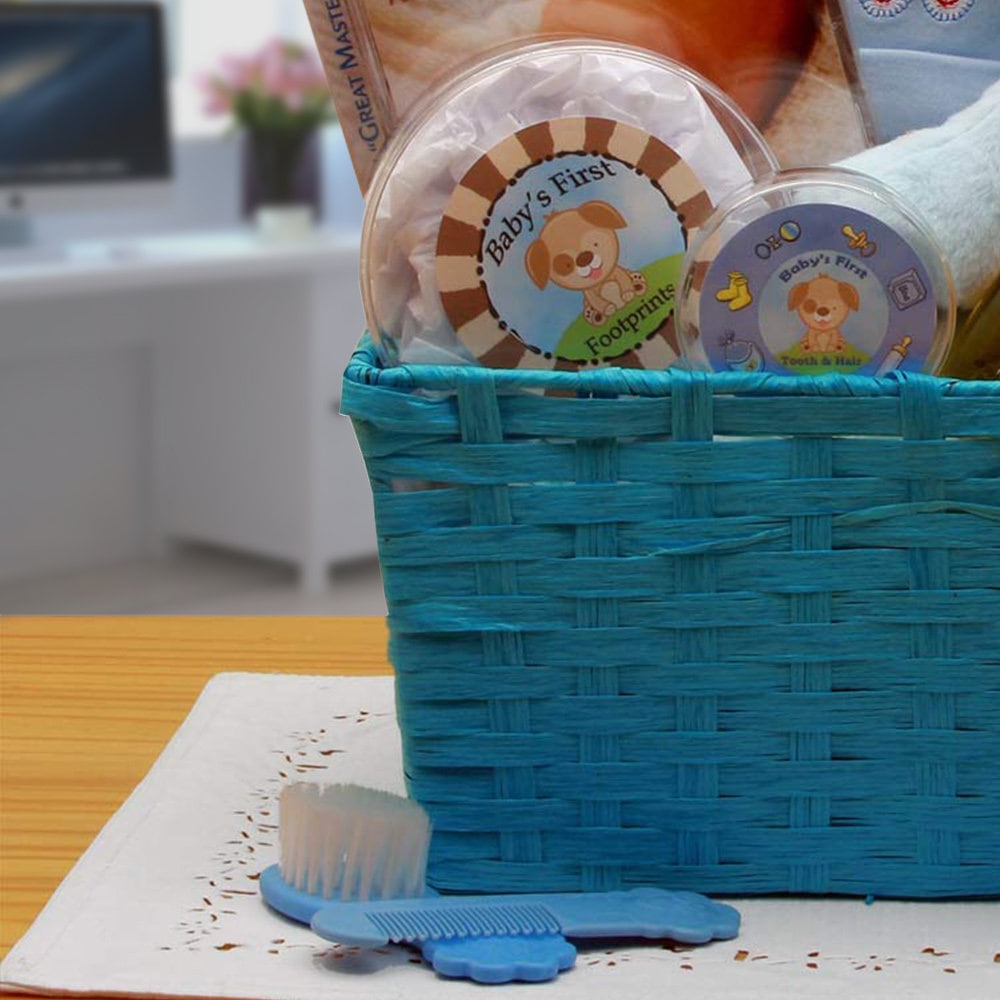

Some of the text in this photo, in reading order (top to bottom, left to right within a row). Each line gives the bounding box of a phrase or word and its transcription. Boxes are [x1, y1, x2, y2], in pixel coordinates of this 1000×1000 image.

[485, 157, 618, 268] Baby's First
[779, 253, 869, 283] Baby's First
[583, 280, 677, 357] Footprints
